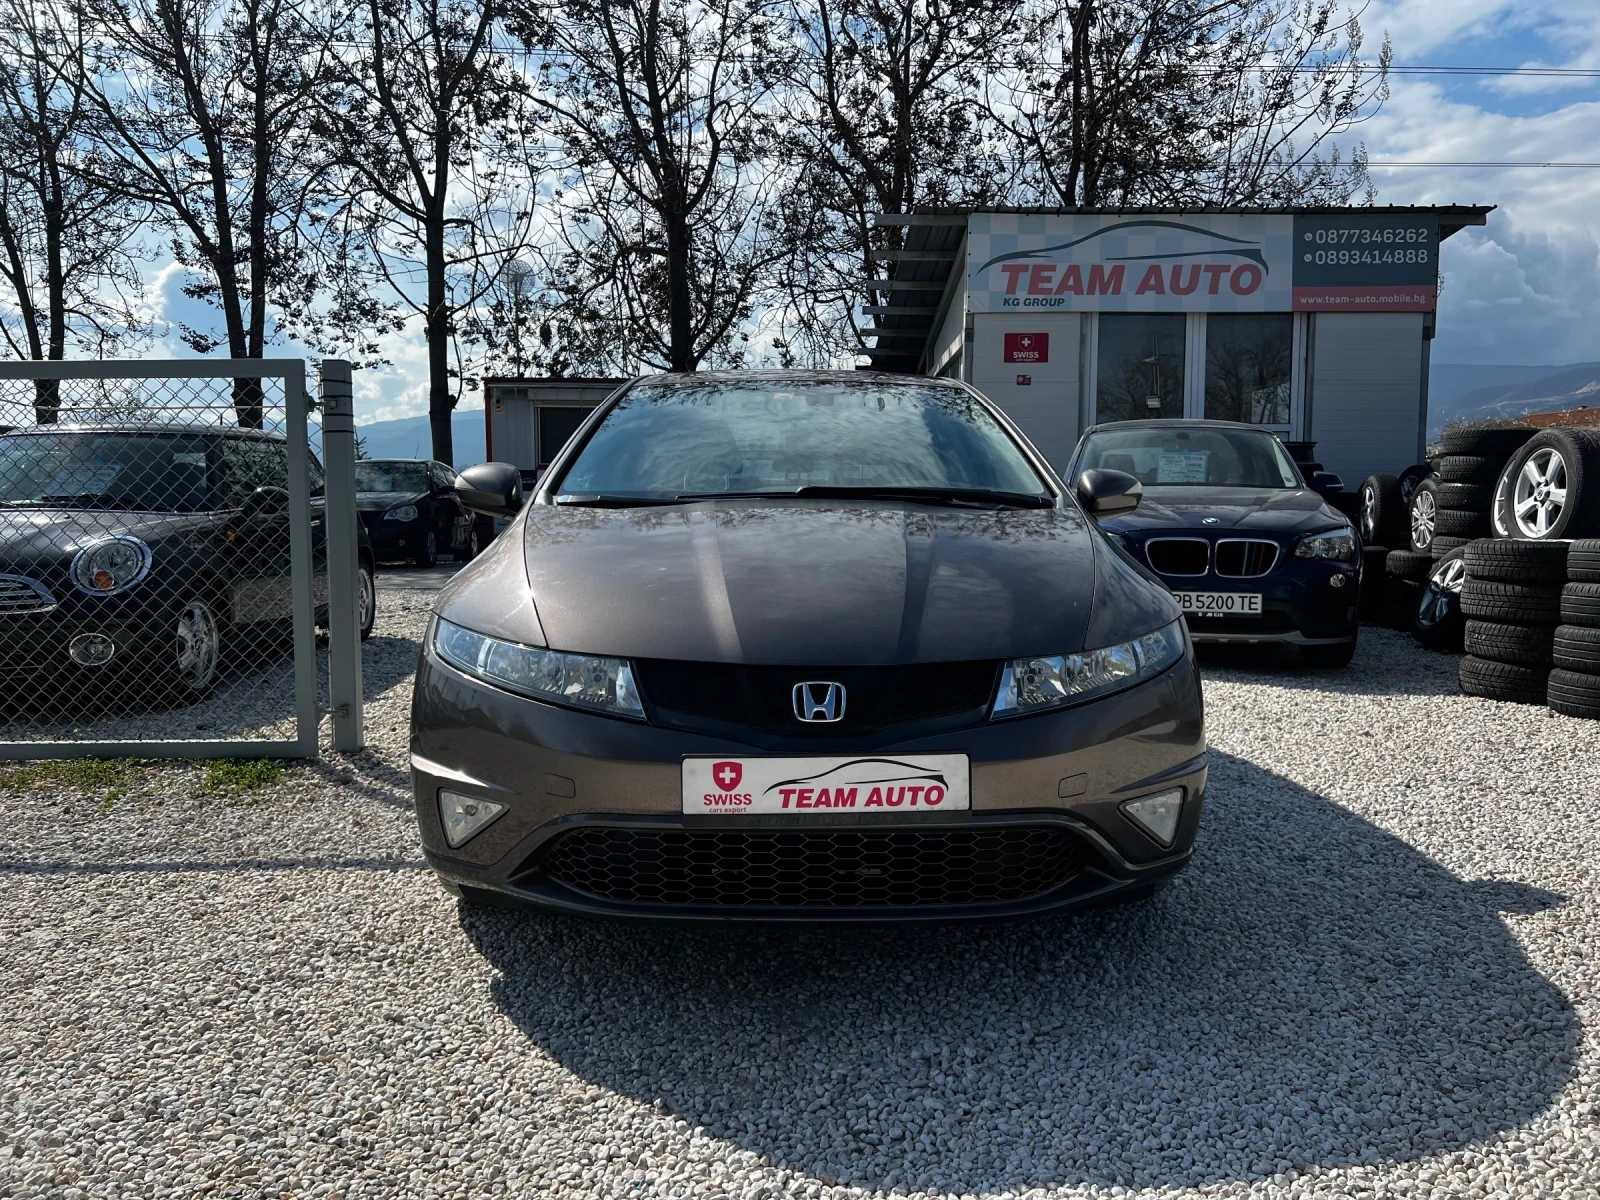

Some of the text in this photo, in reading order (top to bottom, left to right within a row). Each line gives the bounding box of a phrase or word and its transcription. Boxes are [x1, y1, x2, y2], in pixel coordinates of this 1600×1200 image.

[1315, 229, 1428, 244] 0877346262
[1315, 249, 1428, 264] 0893414888
[1000, 263, 1262, 296] TEAM AUTO
[1002, 297, 1065, 307] KG GROUP
[1299, 294, 1426, 304] www.team-auto.mobile.bg
[1012, 351, 1039, 359] SWISS
[1195, 594, 1235, 610] 5200
[1238, 595, 1259, 611] TE
[703, 785, 945, 809] SWISS TEAM AUTO
[724, 807, 747, 815] export
